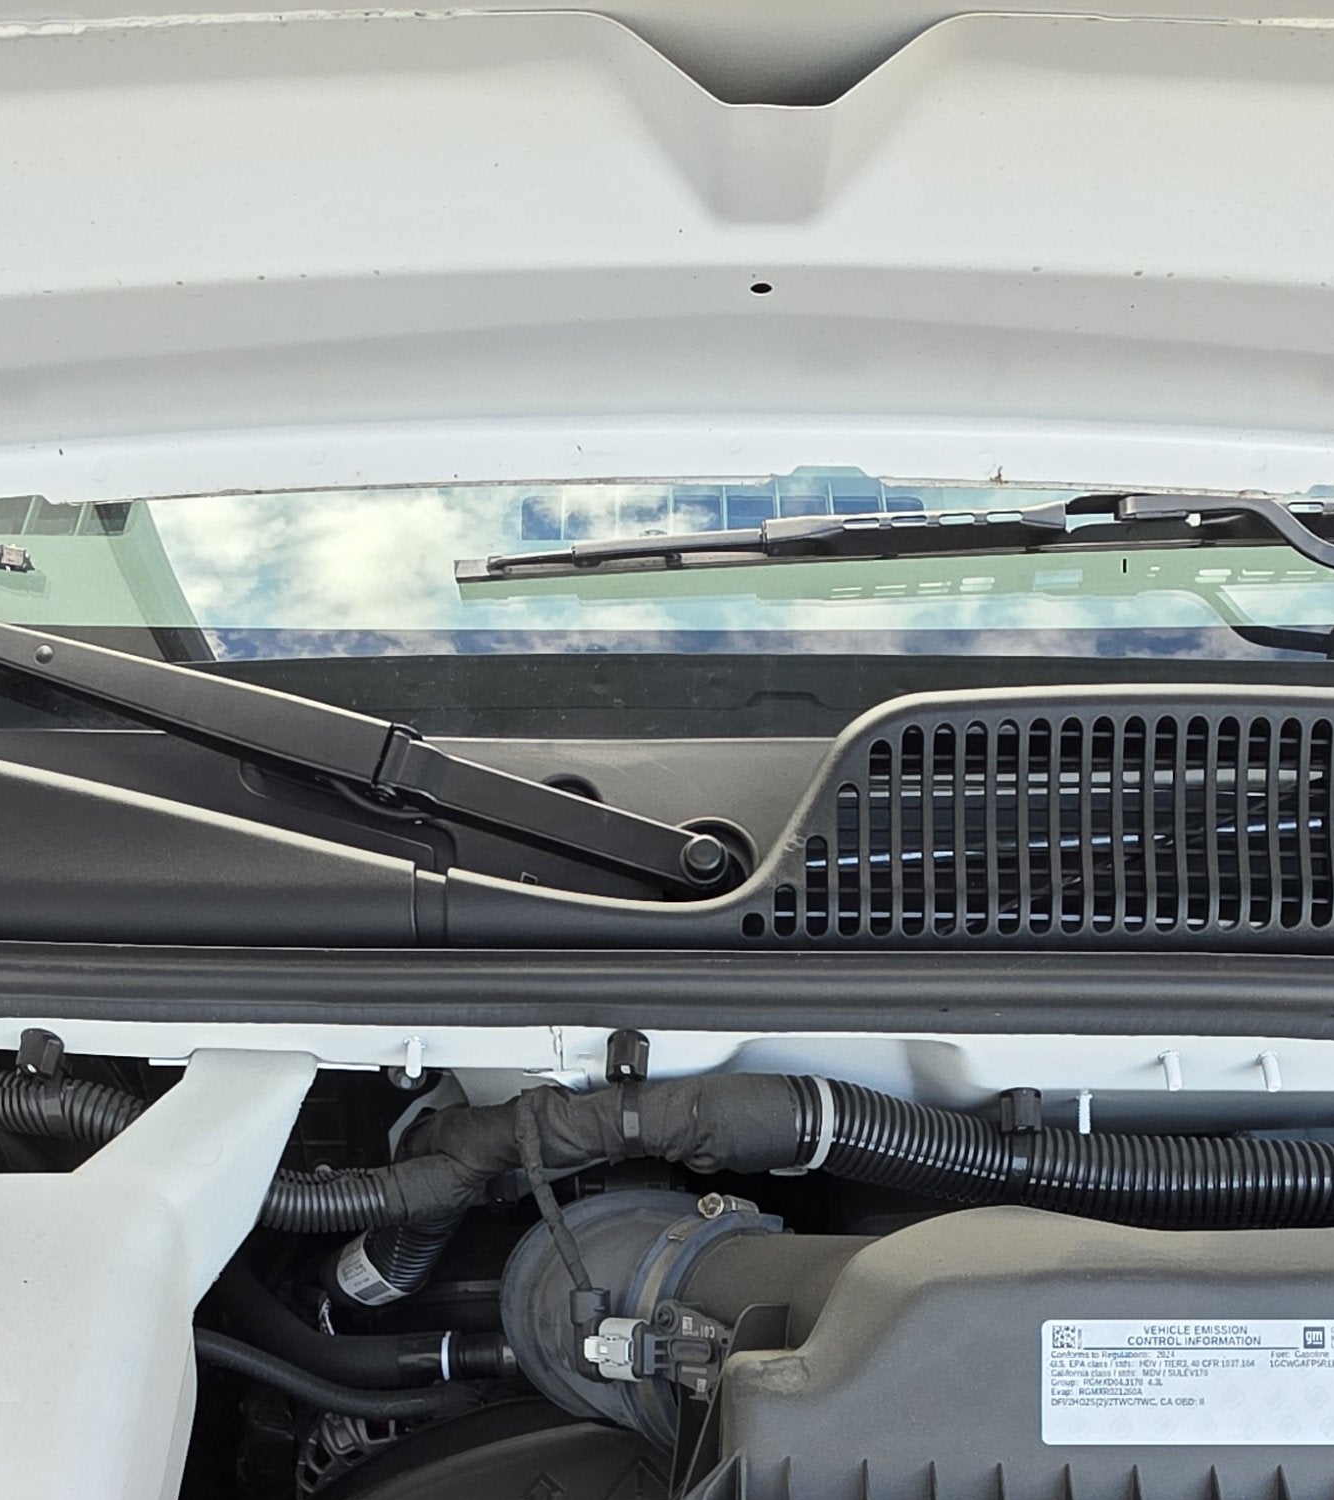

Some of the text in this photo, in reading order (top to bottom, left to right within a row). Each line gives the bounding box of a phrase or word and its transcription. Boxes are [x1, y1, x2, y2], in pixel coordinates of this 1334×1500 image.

[1143, 1326, 1248, 1334] VEHICLE EMISSION
[1128, 1336, 1261, 1346] CONTROL INFORMATION
[1102, 1351, 1151, 1360] Regulations:
[1050, 1360, 1065, 1368] U.S.
[1087, 1360, 1107, 1368] class
[1202, 1359, 1220, 1367] CFR
[1051, 1369, 1089, 1377] California
[1051, 1379, 1079, 1387] Group:
[1160, 1398, 1173, 1406] CA
